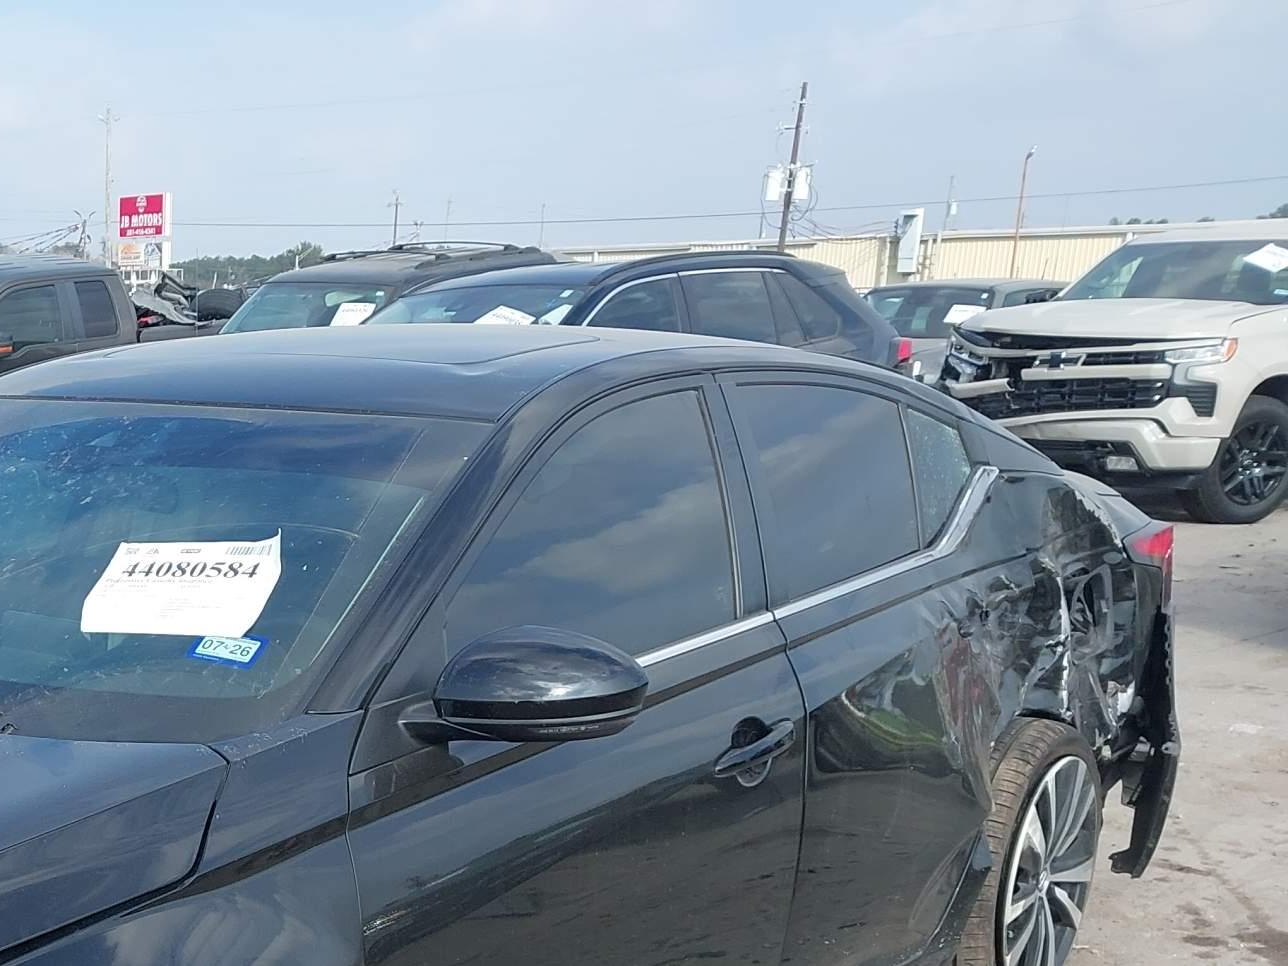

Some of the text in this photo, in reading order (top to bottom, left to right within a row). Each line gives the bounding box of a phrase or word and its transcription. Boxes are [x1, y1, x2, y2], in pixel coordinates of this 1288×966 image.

[120, 212, 163, 228] JB MOTORS
[122, 561, 260, 578] 44080584
[202, 639, 253, 657] 07 26
